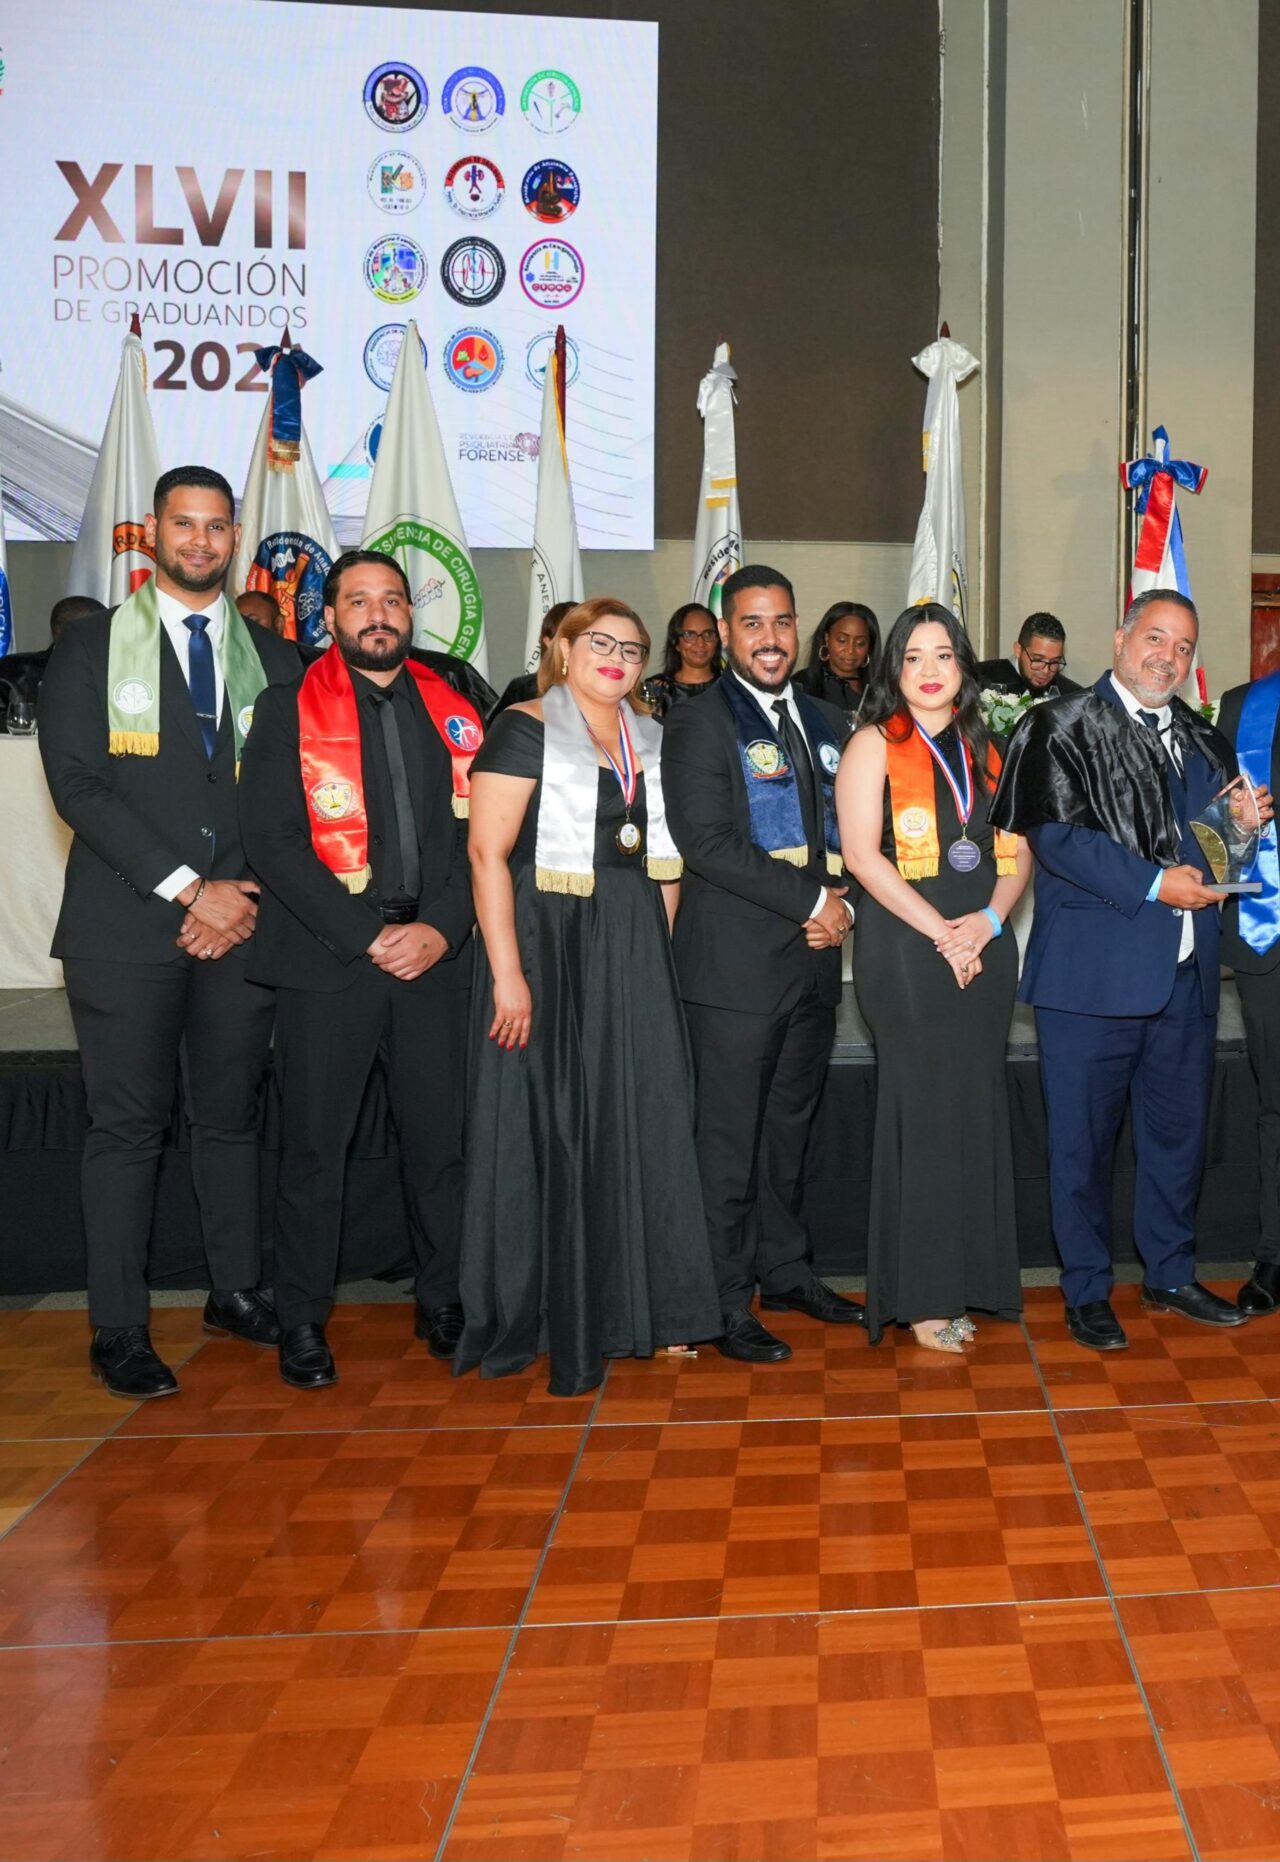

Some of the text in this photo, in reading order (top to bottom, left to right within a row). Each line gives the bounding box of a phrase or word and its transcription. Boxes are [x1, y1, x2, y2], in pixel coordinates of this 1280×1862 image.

[54, 160, 306, 250] XLVII
[54, 255, 306, 297] PROMOCIÓN
[54, 299, 307, 329] DE GRADUANDOS
[153, 340, 306, 391] 202
[459, 449, 525, 462] FORENSE
[432, 539, 453, 559] DE
[450, 557, 477, 621] CIRUGIA
[454, 625, 475, 660] GEN
